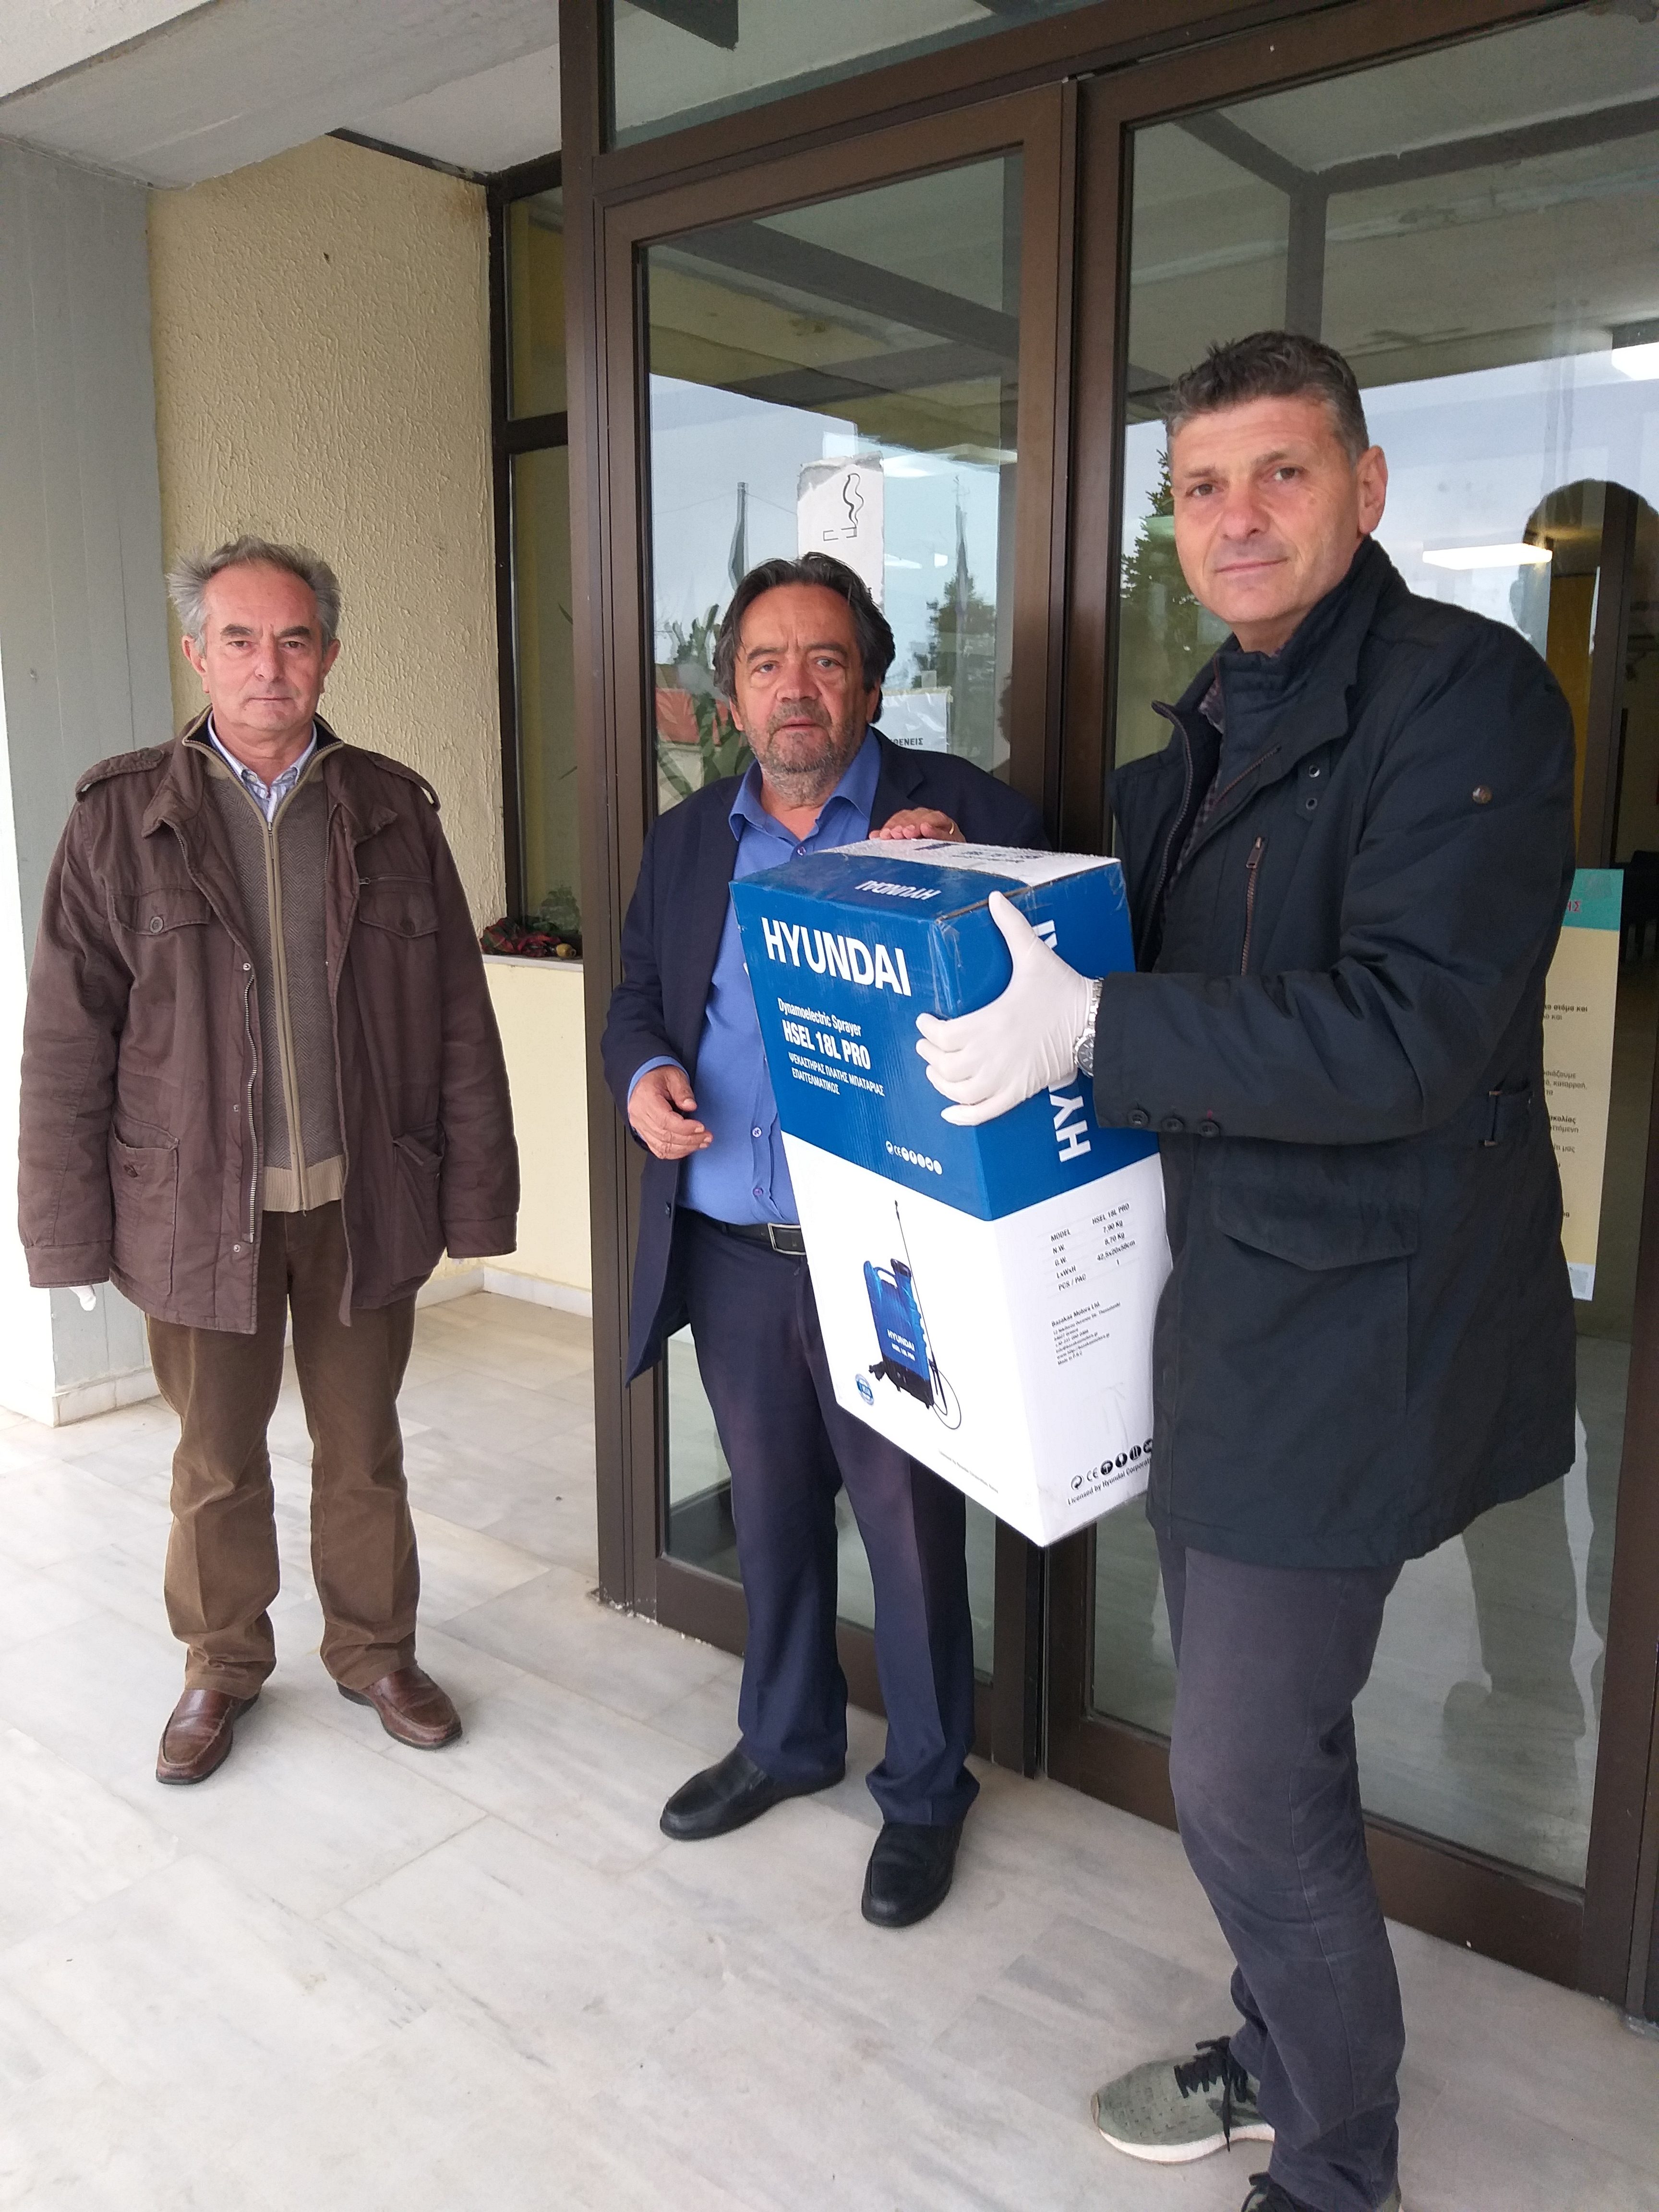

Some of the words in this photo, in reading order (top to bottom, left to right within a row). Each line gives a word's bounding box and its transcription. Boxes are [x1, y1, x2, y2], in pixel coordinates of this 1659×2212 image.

[854, 880, 942, 900] HYUNDAI
[761, 917, 912, 997] HYUNDAI
[777, 997, 832, 1027] Dynamoelectric
[831, 1014, 862, 1037] Sprayer
[781, 1019, 816, 1051] HSEL
[815, 1031, 842, 1060] 18L
[841, 1039, 871, 1070] PRO
[848, 1073, 885, 1097] ΜΠΑΤΑΡΙΑΣ
[1051, 1229, 1071, 1242] MODEL
[1092, 1214, 1106, 1225] HSEL
[887, 1329, 915, 1352] HYUNDAI
[1068, 1486, 1094, 1506] Licensed
[1094, 1484, 1102, 1493] by
